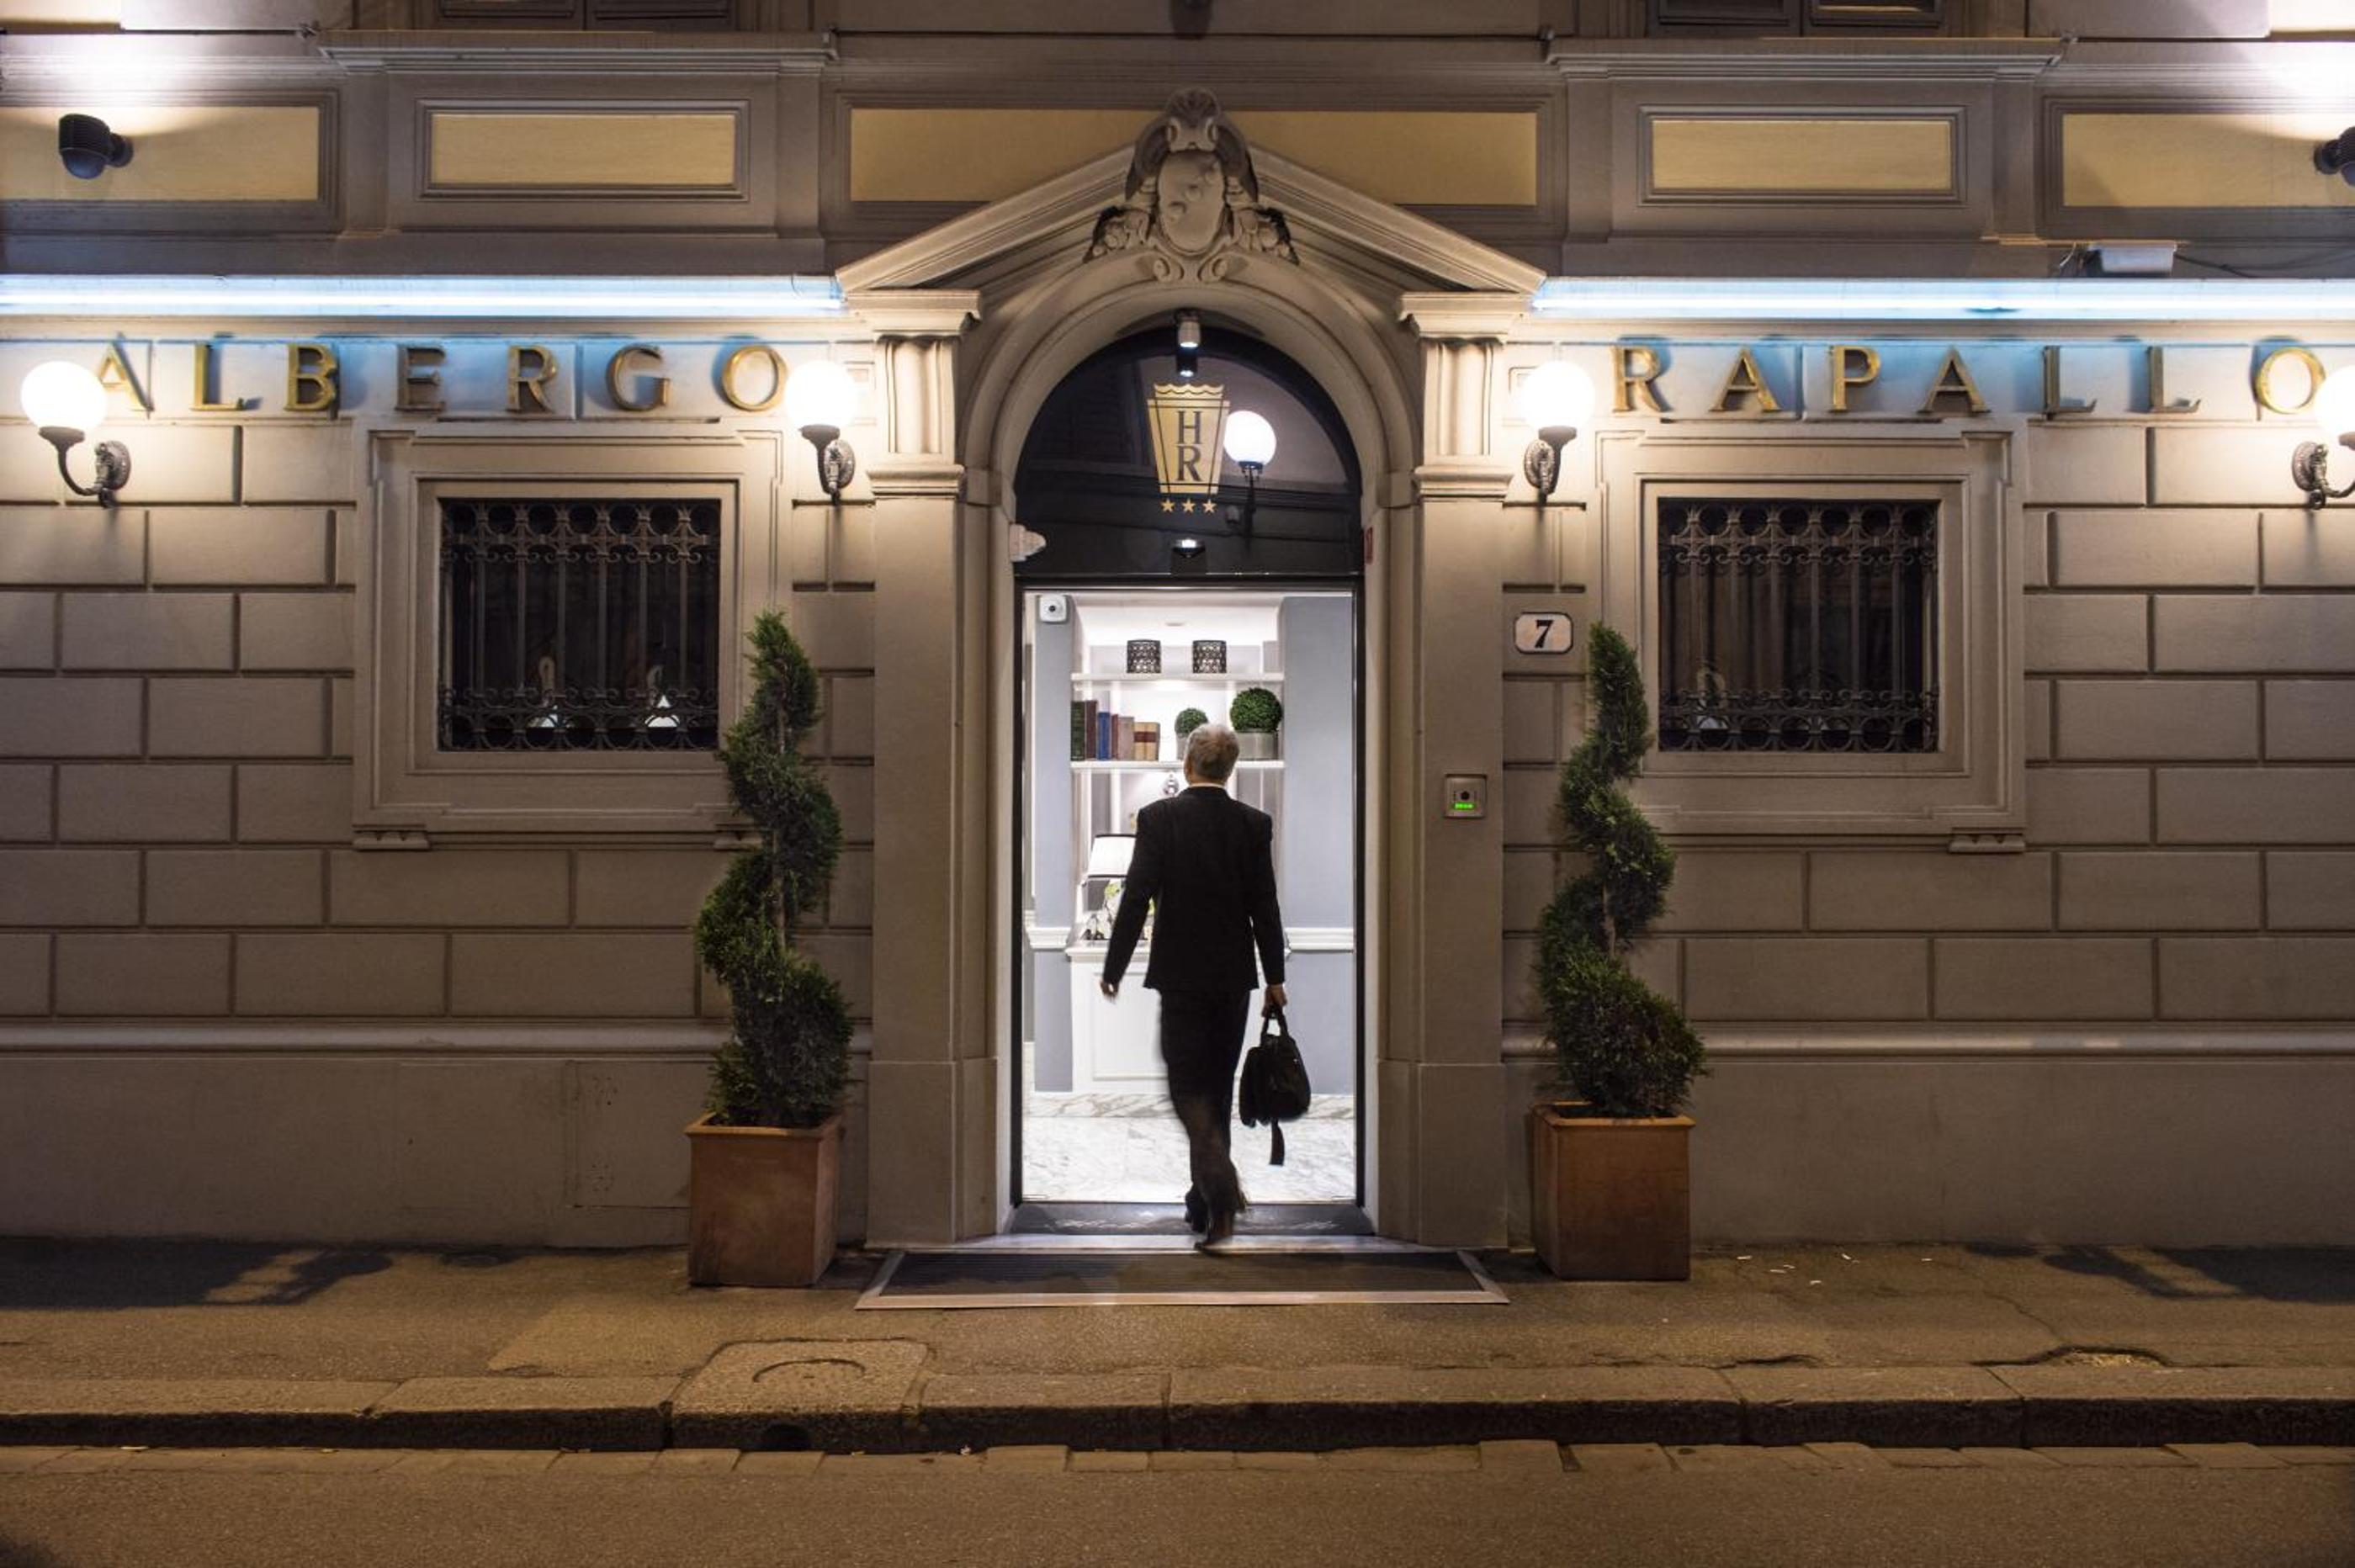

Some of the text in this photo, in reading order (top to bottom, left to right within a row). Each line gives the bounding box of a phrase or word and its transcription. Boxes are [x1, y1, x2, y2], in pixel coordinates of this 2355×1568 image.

[97, 343, 788, 414] ALBERGO
[1610, 345, 2326, 415] RAPALLO
[1175, 411, 1203, 444] H
[1175, 445, 1203, 481] R
[1534, 619, 1554, 649] 7
